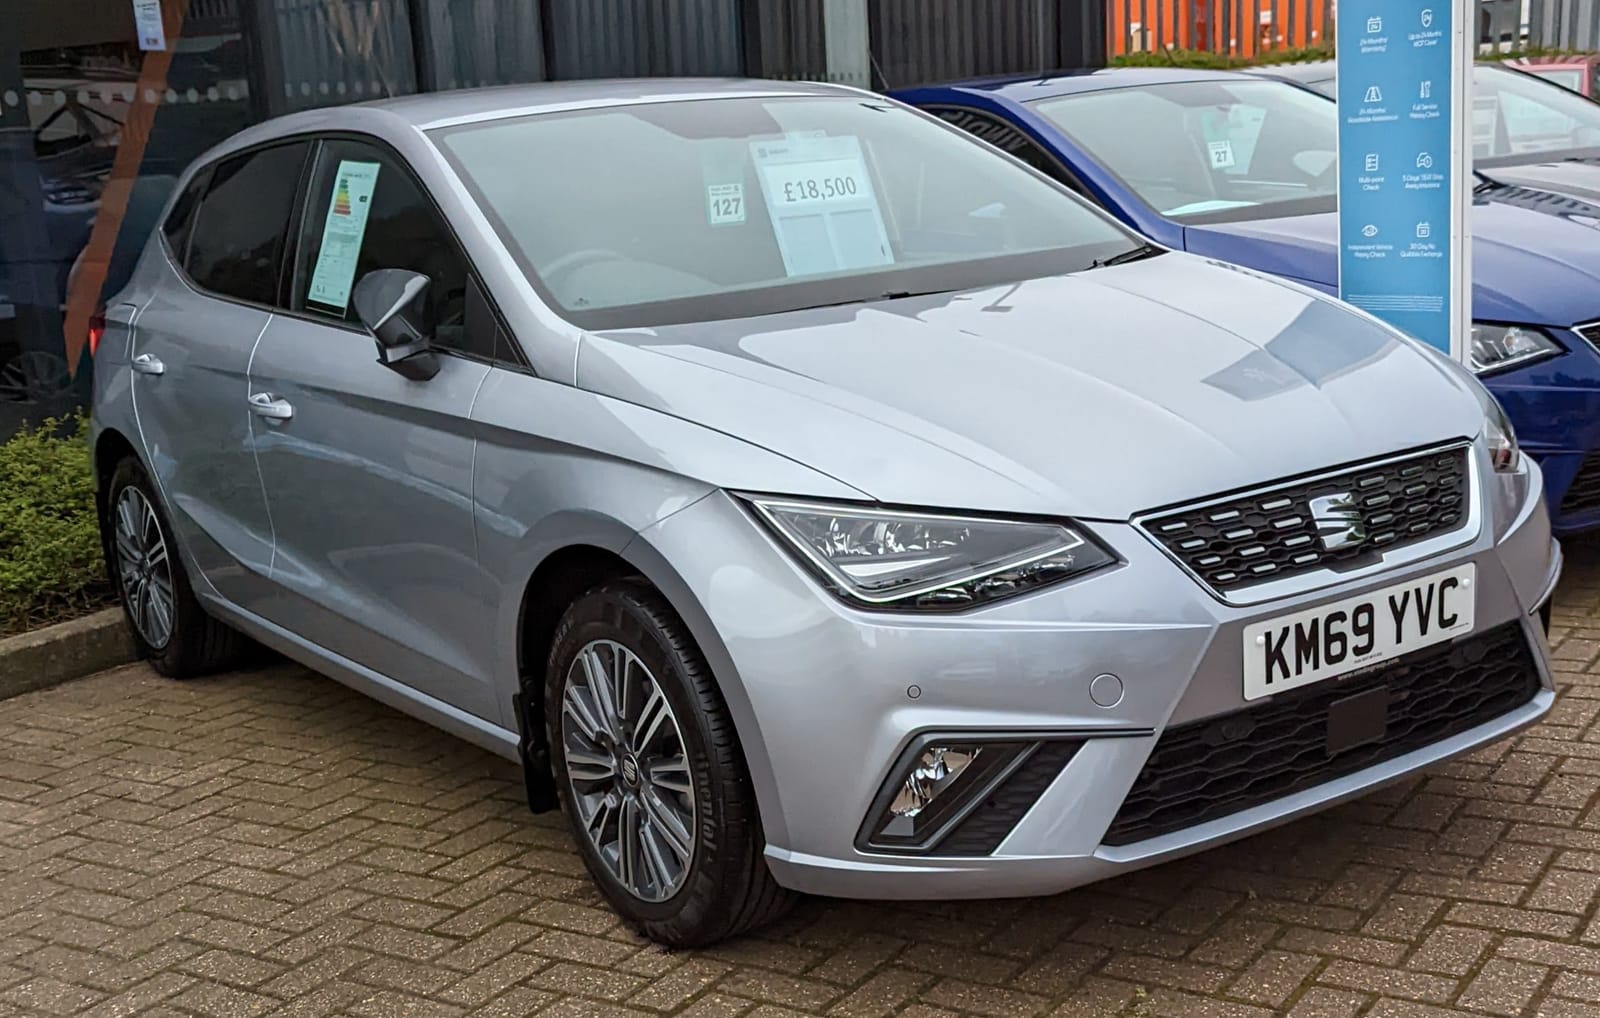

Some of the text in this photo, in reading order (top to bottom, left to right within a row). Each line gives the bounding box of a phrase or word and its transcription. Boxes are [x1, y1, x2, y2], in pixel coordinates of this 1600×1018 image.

[1215, 150, 1227, 163] 27
[783, 176, 857, 202] £18,500
[713, 197, 741, 217] 127
[1263, 576, 1459, 686] KM69 YVC
